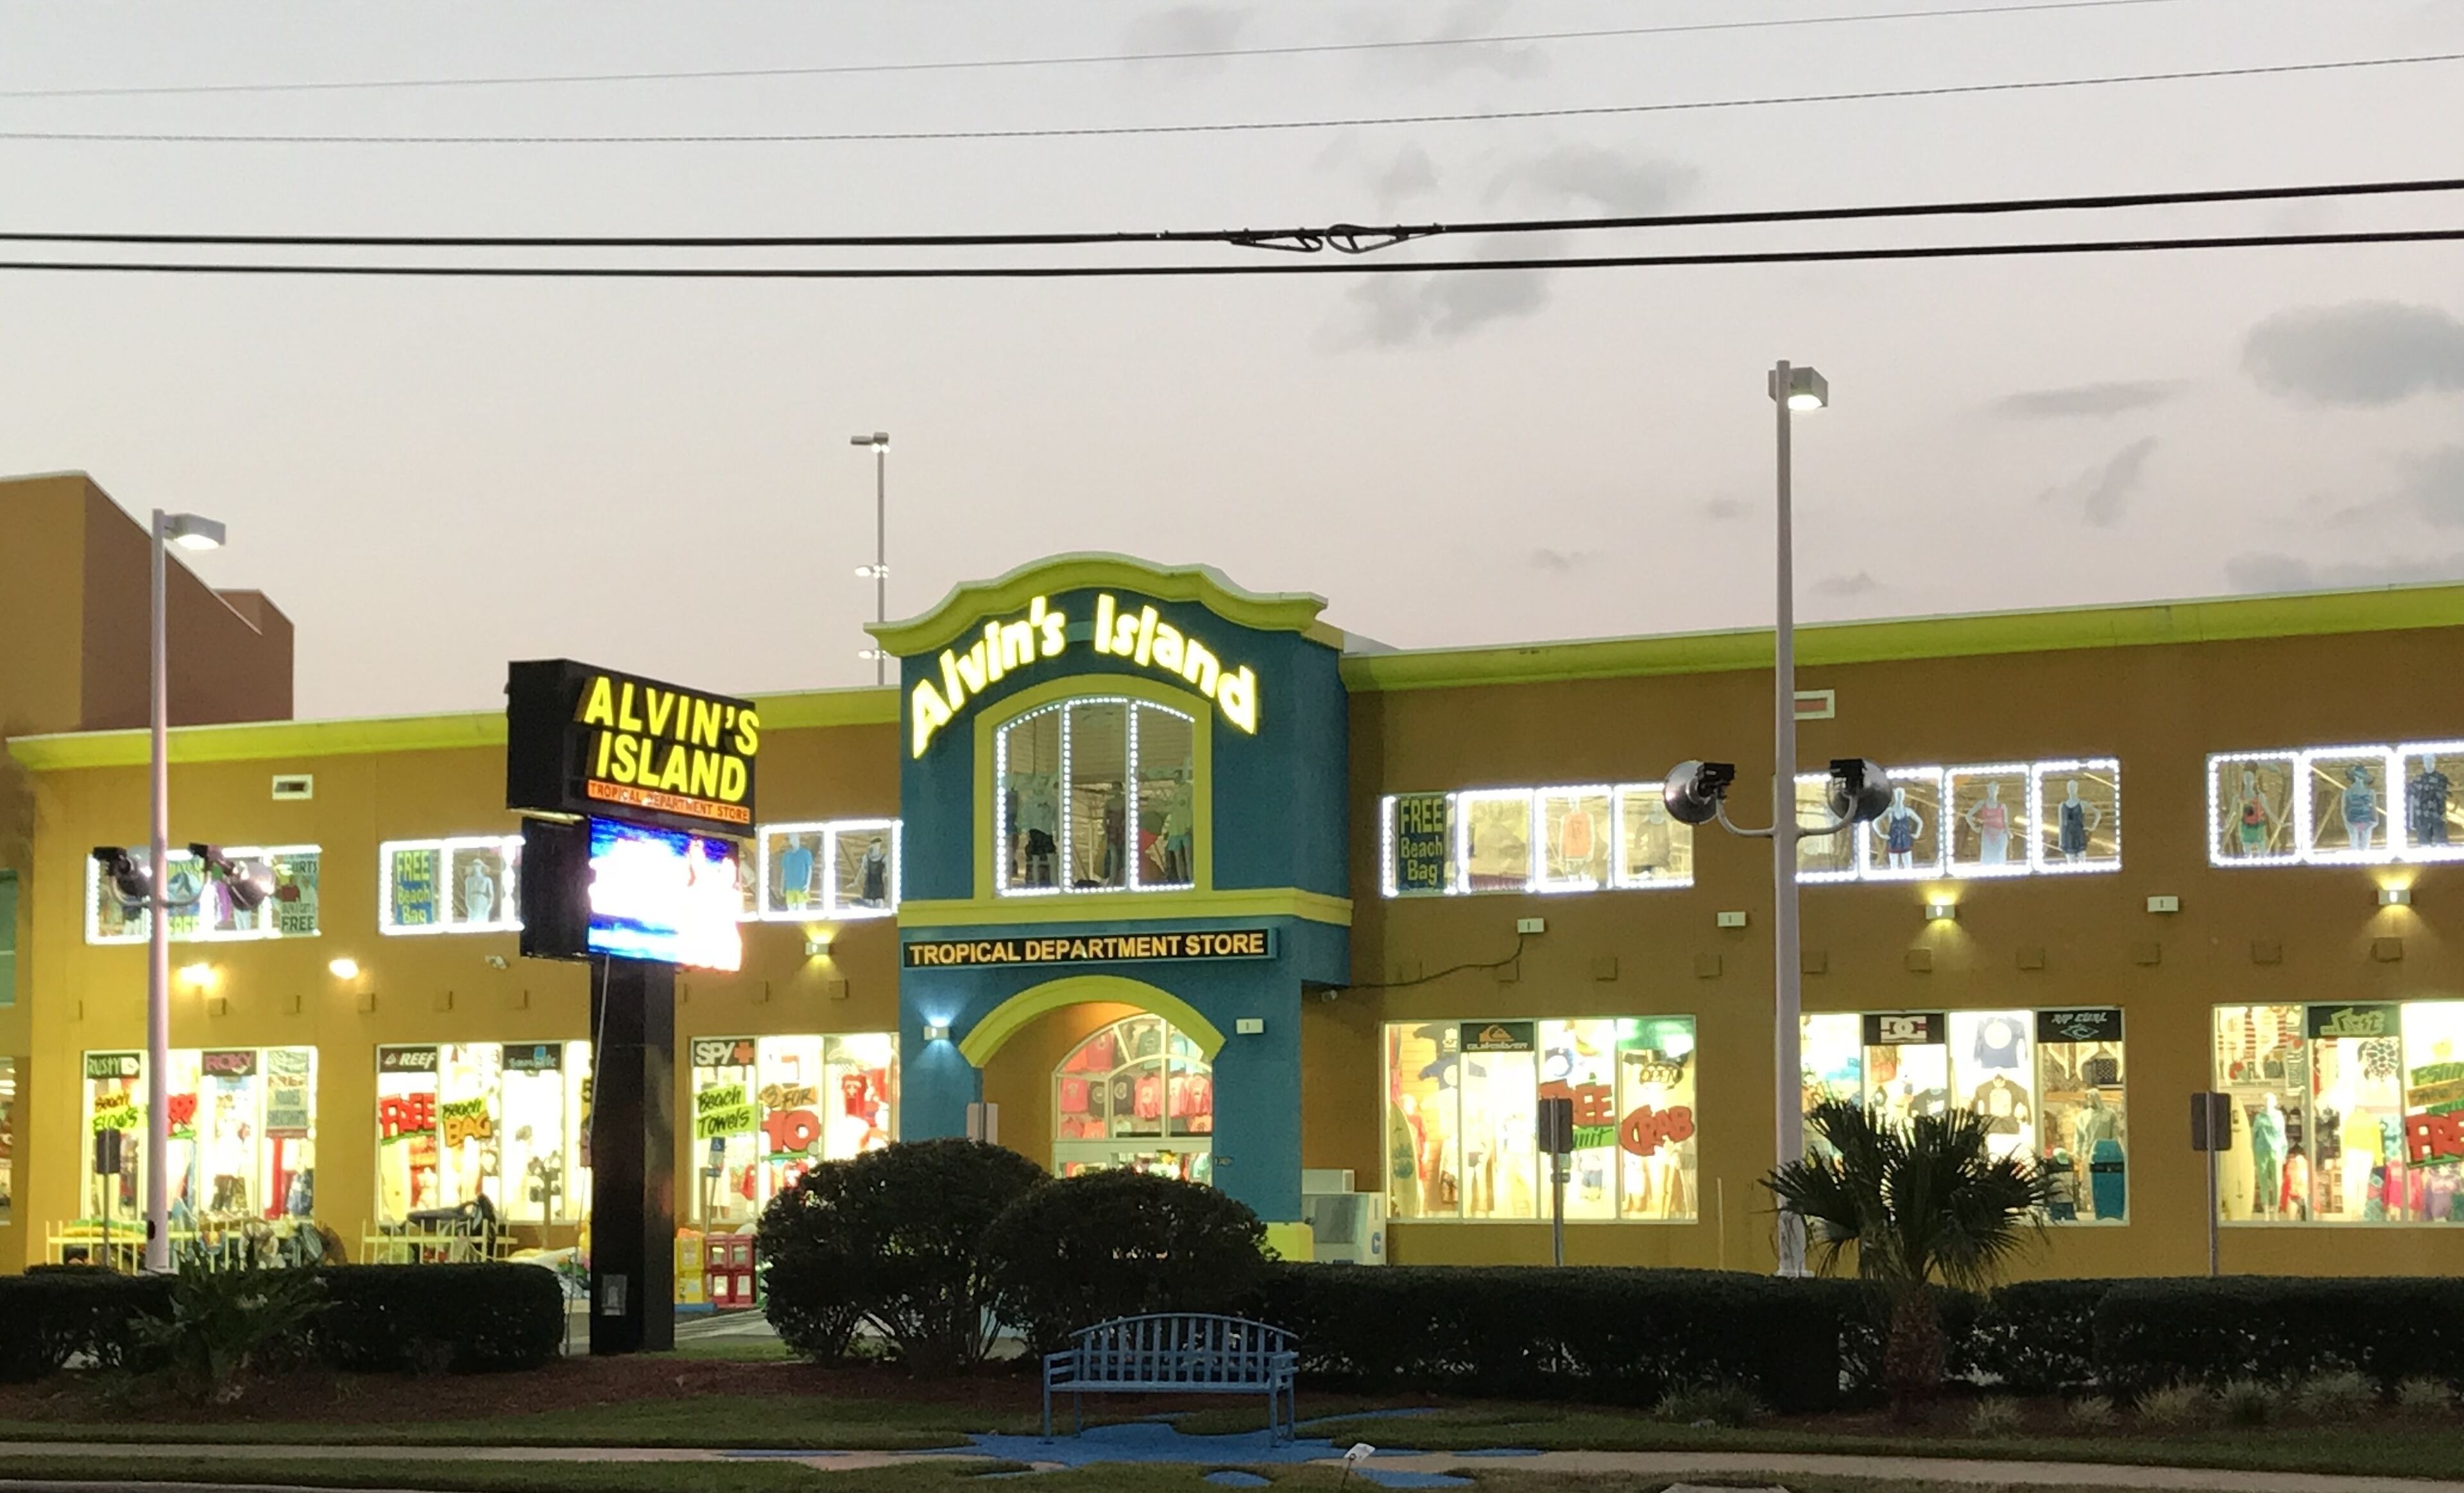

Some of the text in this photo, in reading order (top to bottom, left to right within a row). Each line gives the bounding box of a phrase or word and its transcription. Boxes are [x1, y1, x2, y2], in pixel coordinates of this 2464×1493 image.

[912, 593, 1257, 759] Alvin's Island
[583, 676, 760, 756] ALVIN'S
[595, 731, 748, 802] ISLAND
[590, 782, 749, 821] TROPICAL DEPARTMENT STORE
[1400, 798, 1444, 834] FREE
[1400, 835, 1442, 858] Beach
[396, 850, 431, 883] FREE
[1407, 859, 1438, 886] Bag
[397, 884, 431, 904] Beach
[281, 915, 314, 931] FREE
[402, 905, 427, 925] Bag
[909, 932, 1264, 965] TROPICAL DEPARTMENT STORE
[205, 1051, 252, 1071] ROXY
[696, 1042, 735, 1066] SPY
[379, 1092, 436, 1137] FREE
[444, 1112, 493, 1148] BAG
[762, 1110, 821, 1152] 10
[1620, 1105, 1695, 1156] CRAB
